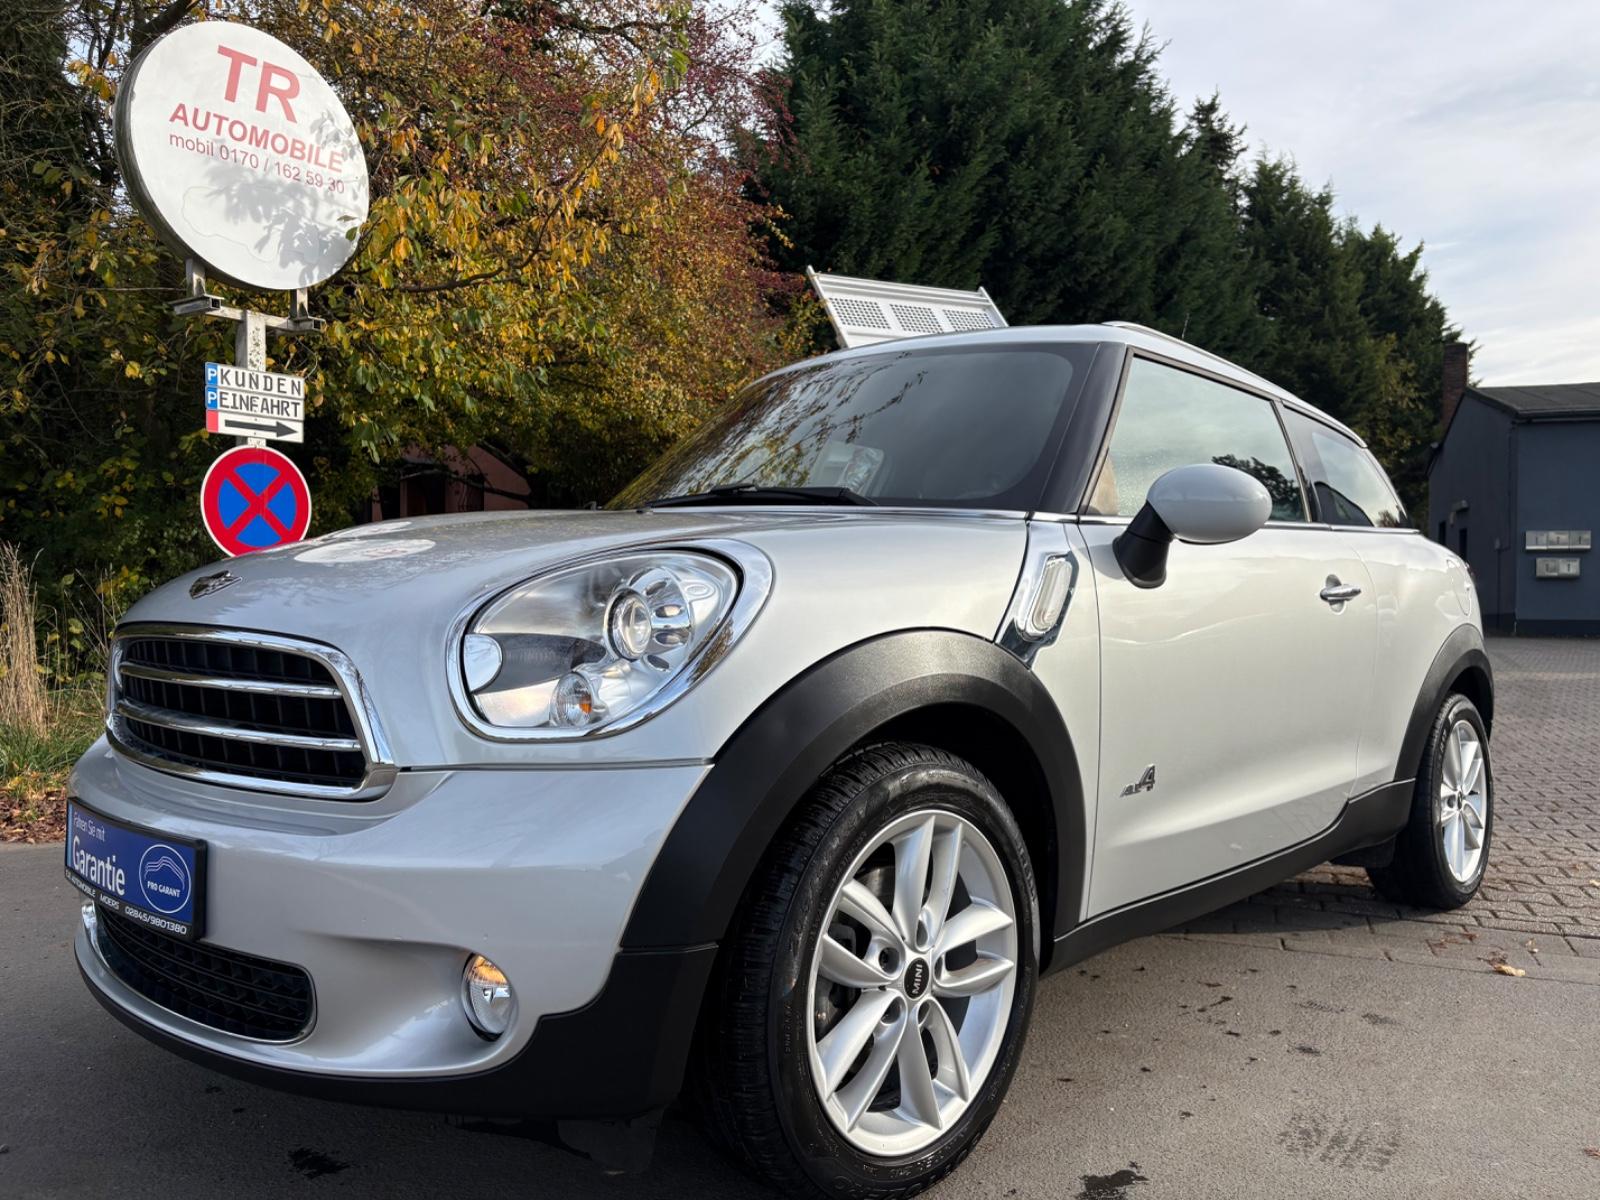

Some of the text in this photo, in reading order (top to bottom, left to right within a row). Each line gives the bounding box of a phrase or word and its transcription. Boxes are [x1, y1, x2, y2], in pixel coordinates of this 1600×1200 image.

[218, 45, 300, 123] TR
[169, 103, 343, 173] AUTOMOBILE
[169, 134, 214, 157] mobil
[220, 144, 259, 169] 0170
[274, 161, 302, 182] 162
[306, 170, 324, 188] 59
[328, 177, 345, 194] 30
[219, 391, 301, 418] EINFAHRT
[220, 368, 301, 396] KUNDEN
[72, 835, 126, 896] Garantie
[911, 963, 923, 995] MINI
